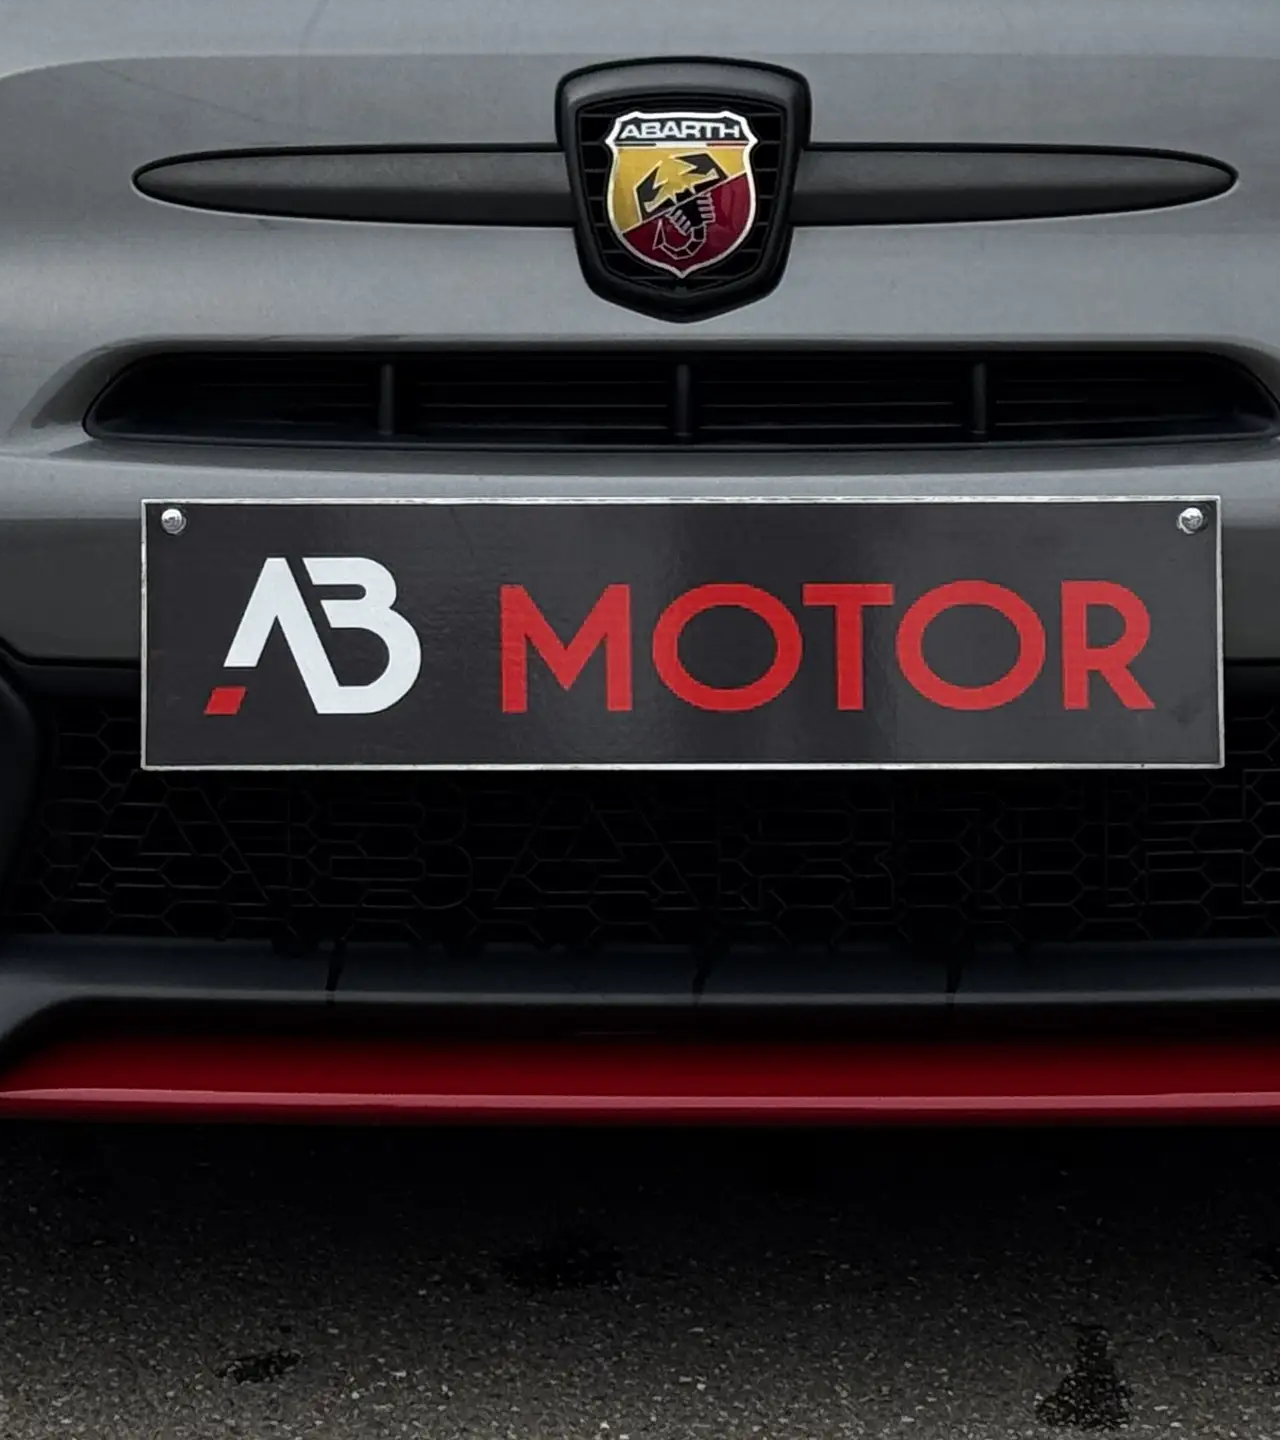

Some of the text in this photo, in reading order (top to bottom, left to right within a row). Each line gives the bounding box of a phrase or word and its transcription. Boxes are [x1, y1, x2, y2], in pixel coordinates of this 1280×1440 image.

[619, 120, 741, 140] ABARTH
[203, 556, 1157, 715] AB MOTOR
